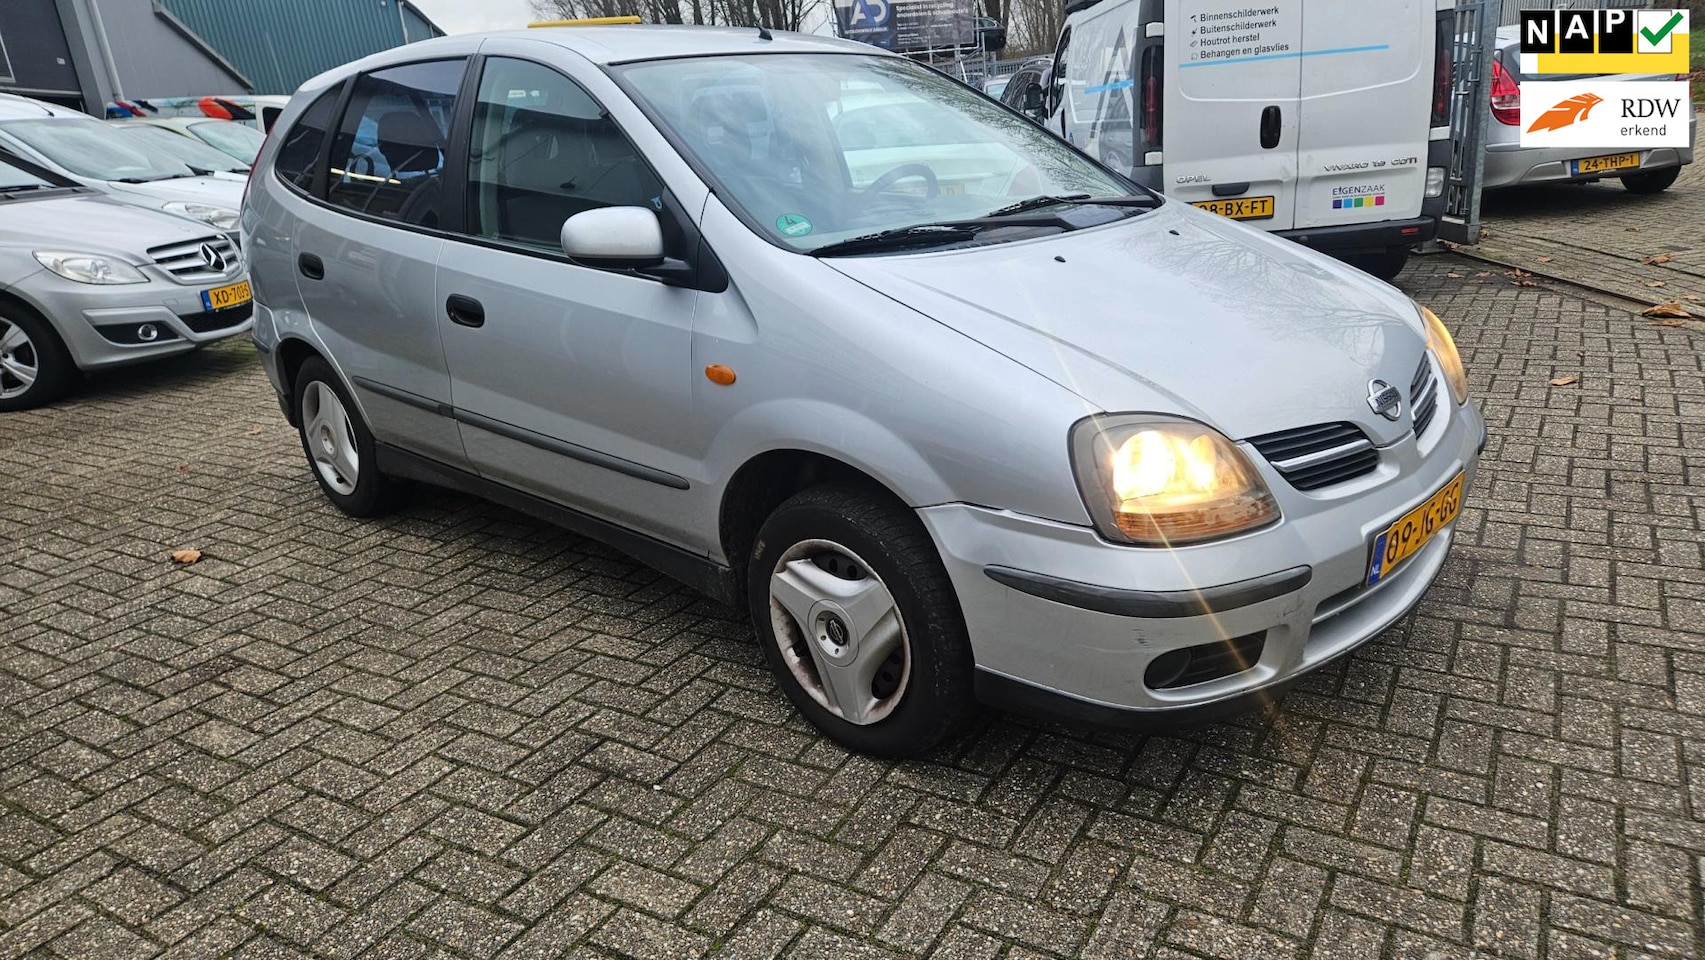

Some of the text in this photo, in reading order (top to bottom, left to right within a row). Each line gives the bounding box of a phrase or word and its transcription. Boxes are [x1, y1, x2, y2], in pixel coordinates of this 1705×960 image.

[1200, 6, 1279, 22] Binnenschilderwerk
[1200, 18, 1277, 34] Buitenschilderwerk
[1200, 33, 1260, 47] Houtrot herstel
[1200, 43, 1289, 59] Behangen en glasvlies
[1584, 154, 1634, 171] 24-THP-1
[1176, 173, 1211, 184] OPEL
[784, 215, 797, 225] 4
[1386, 482, 1459, 564] 09-JG-GG
[1370, 564, 1380, 576] NL
